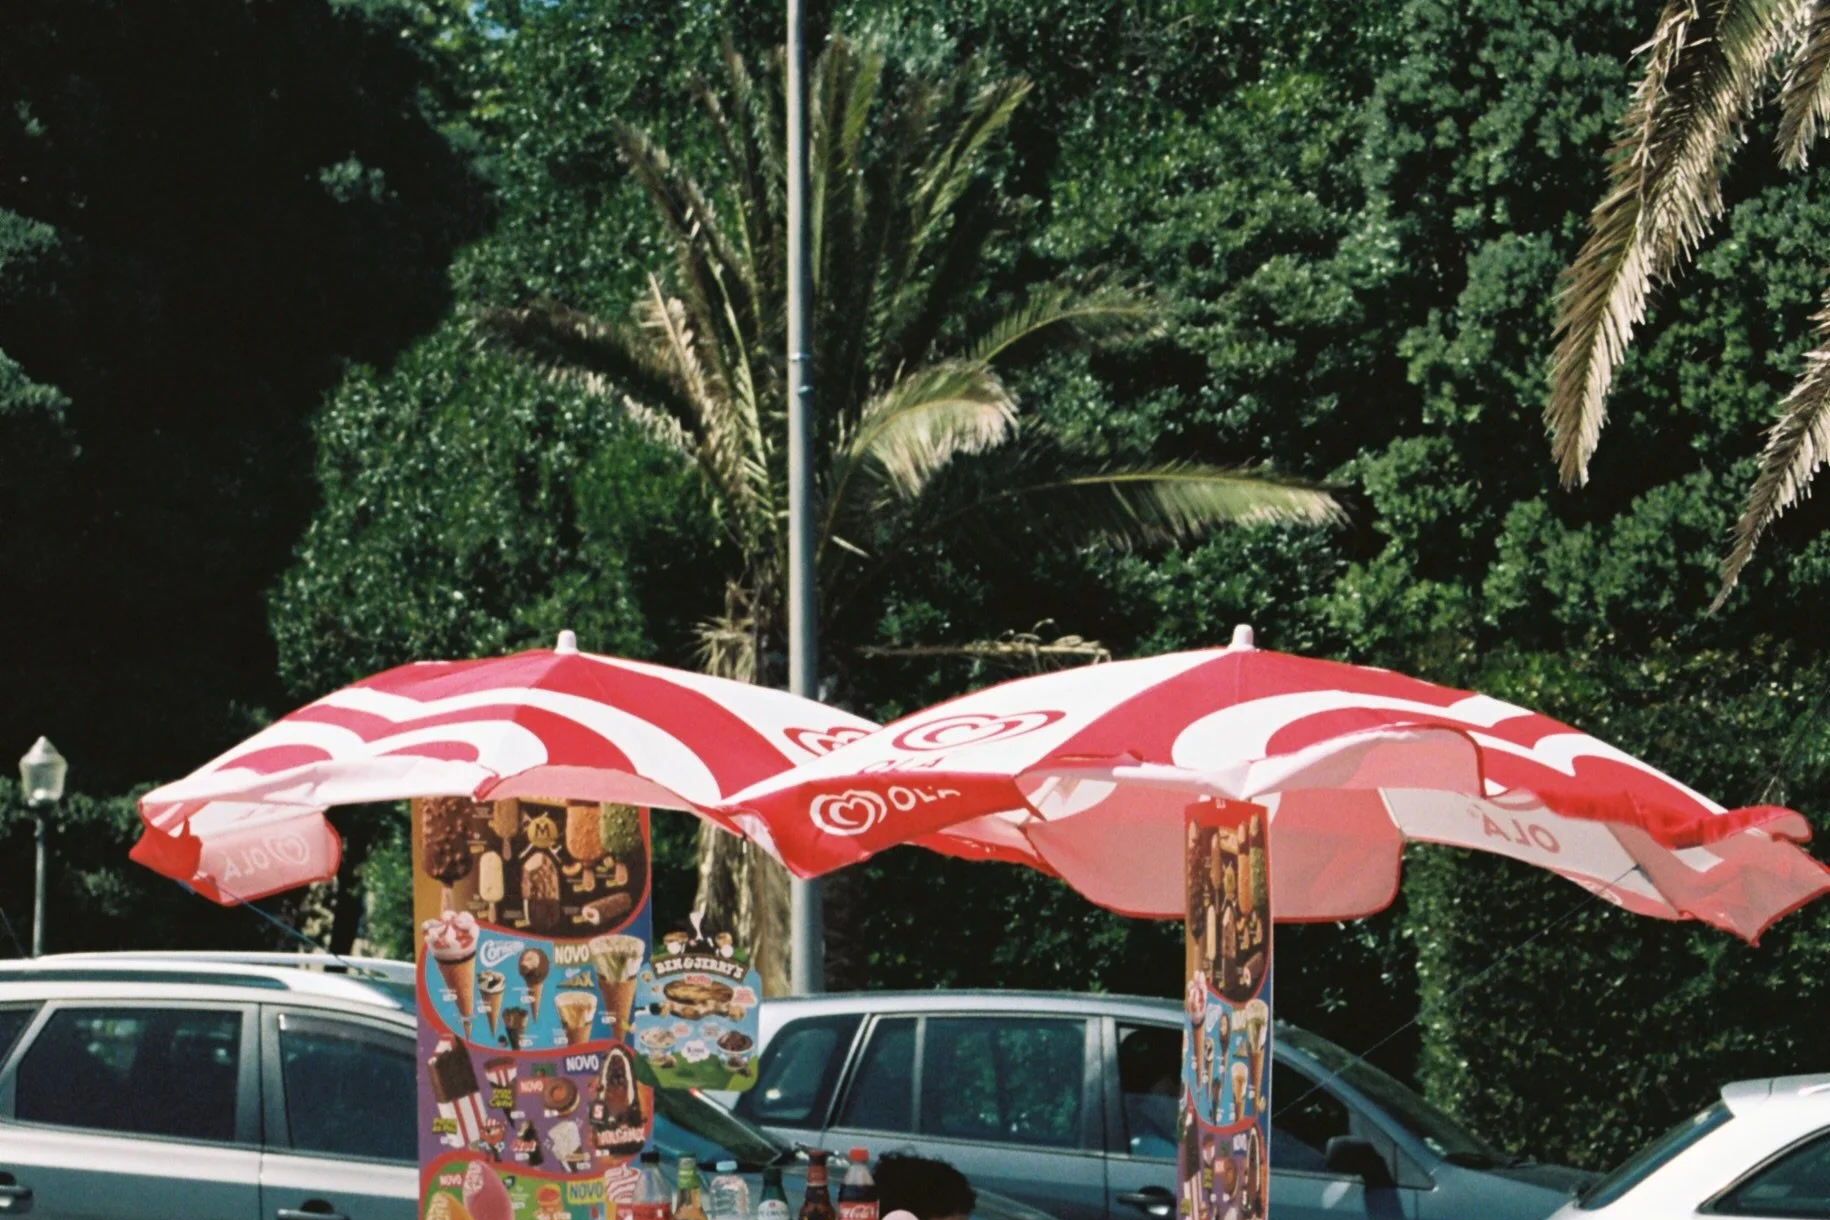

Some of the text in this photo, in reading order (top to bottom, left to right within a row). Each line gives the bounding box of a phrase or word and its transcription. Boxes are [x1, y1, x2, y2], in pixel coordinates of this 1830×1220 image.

[535, 818, 551, 837] M
[555, 944, 590, 965] NOVO
[566, 1054, 600, 1072] NOVO
[570, 1182, 604, 1200] NOVO
